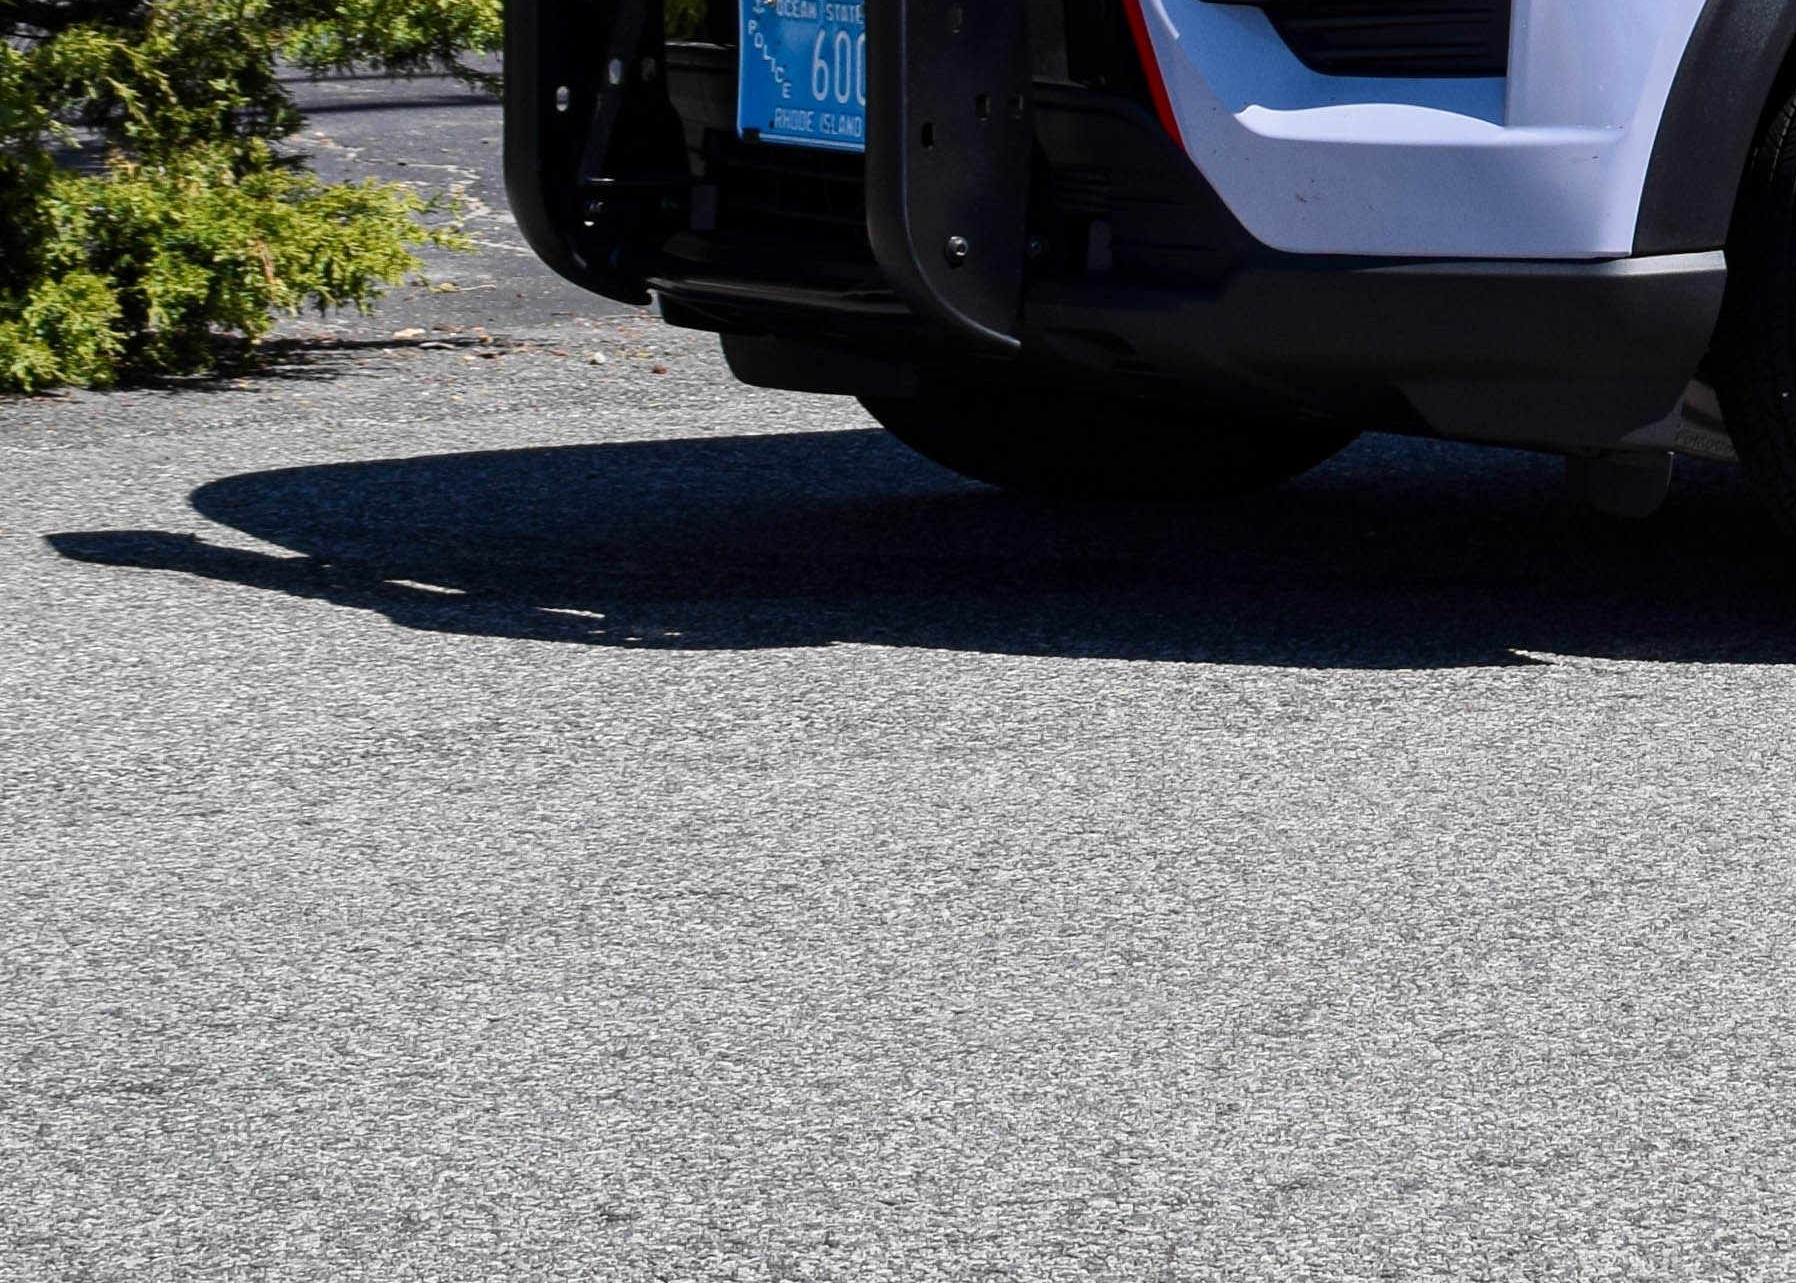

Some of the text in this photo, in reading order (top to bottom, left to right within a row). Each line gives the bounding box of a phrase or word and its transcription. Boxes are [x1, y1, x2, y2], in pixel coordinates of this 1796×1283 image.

[825, 3, 865, 25] STATE
[747, 19, 793, 99] POLICE
[774, 107, 863, 137] RHODE ISLAND
